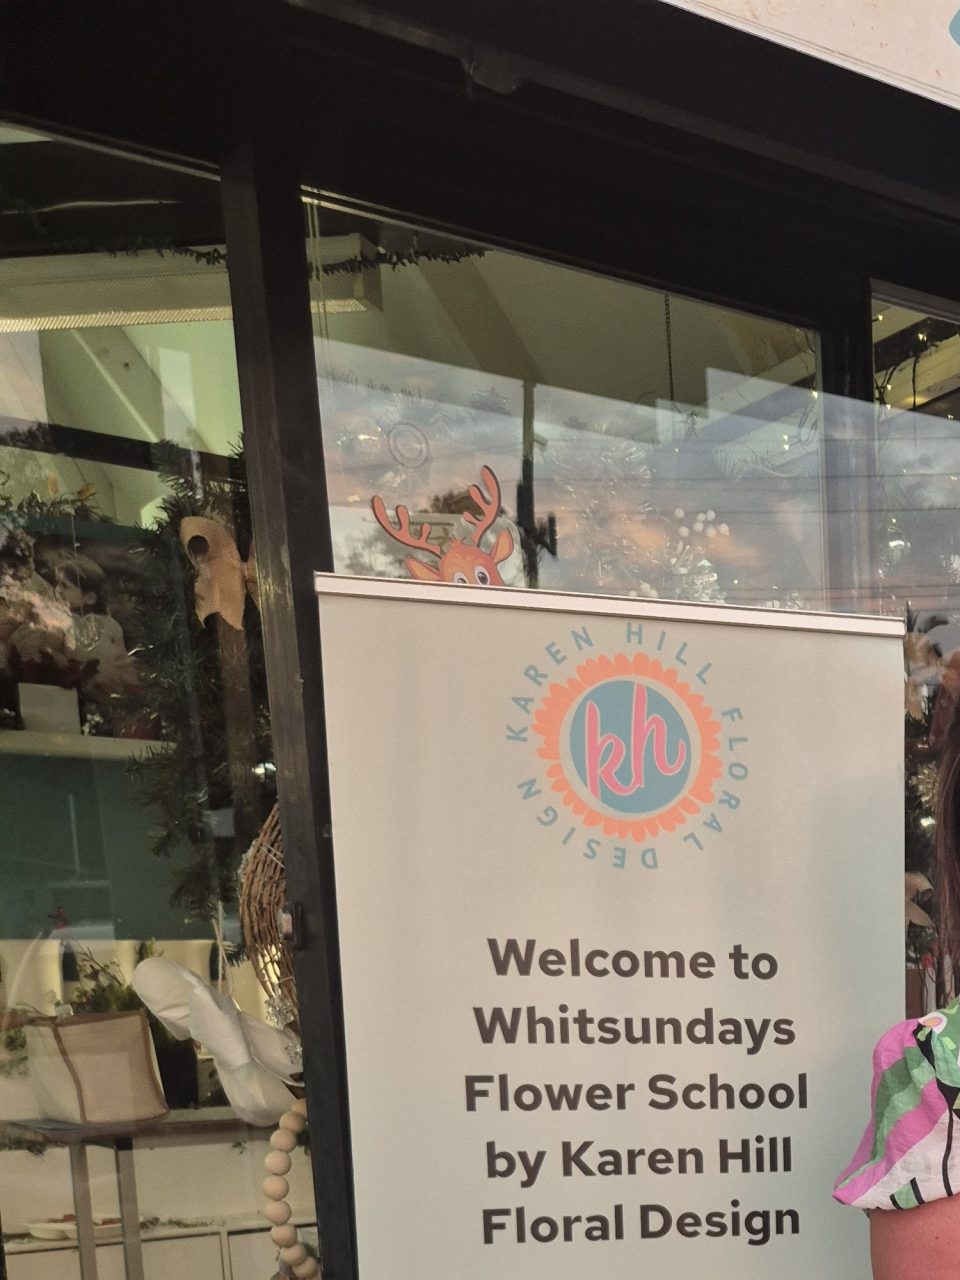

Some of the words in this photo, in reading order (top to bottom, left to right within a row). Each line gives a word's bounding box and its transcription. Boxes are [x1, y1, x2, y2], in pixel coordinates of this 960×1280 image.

[626, 622, 712, 684] HILL
[506, 626, 594, 742] KAREN
[584, 681, 687, 799] kh
[682, 707, 748, 850] FLORAL
[517, 778, 659, 869] DESIGN
[486, 938, 716, 979] Welcome
[728, 944, 778, 980] to
[473, 1003, 796, 1055] Whitsundays
[465, 1073, 635, 1111] Flower
[648, 1072, 808, 1110] School
[486, 1140, 547, 1188] by
[561, 1140, 704, 1177] Karen
[719, 1134, 792, 1173] Hill
[482, 1204, 624, 1244] Floral
[640, 1199, 800, 1246] Design
